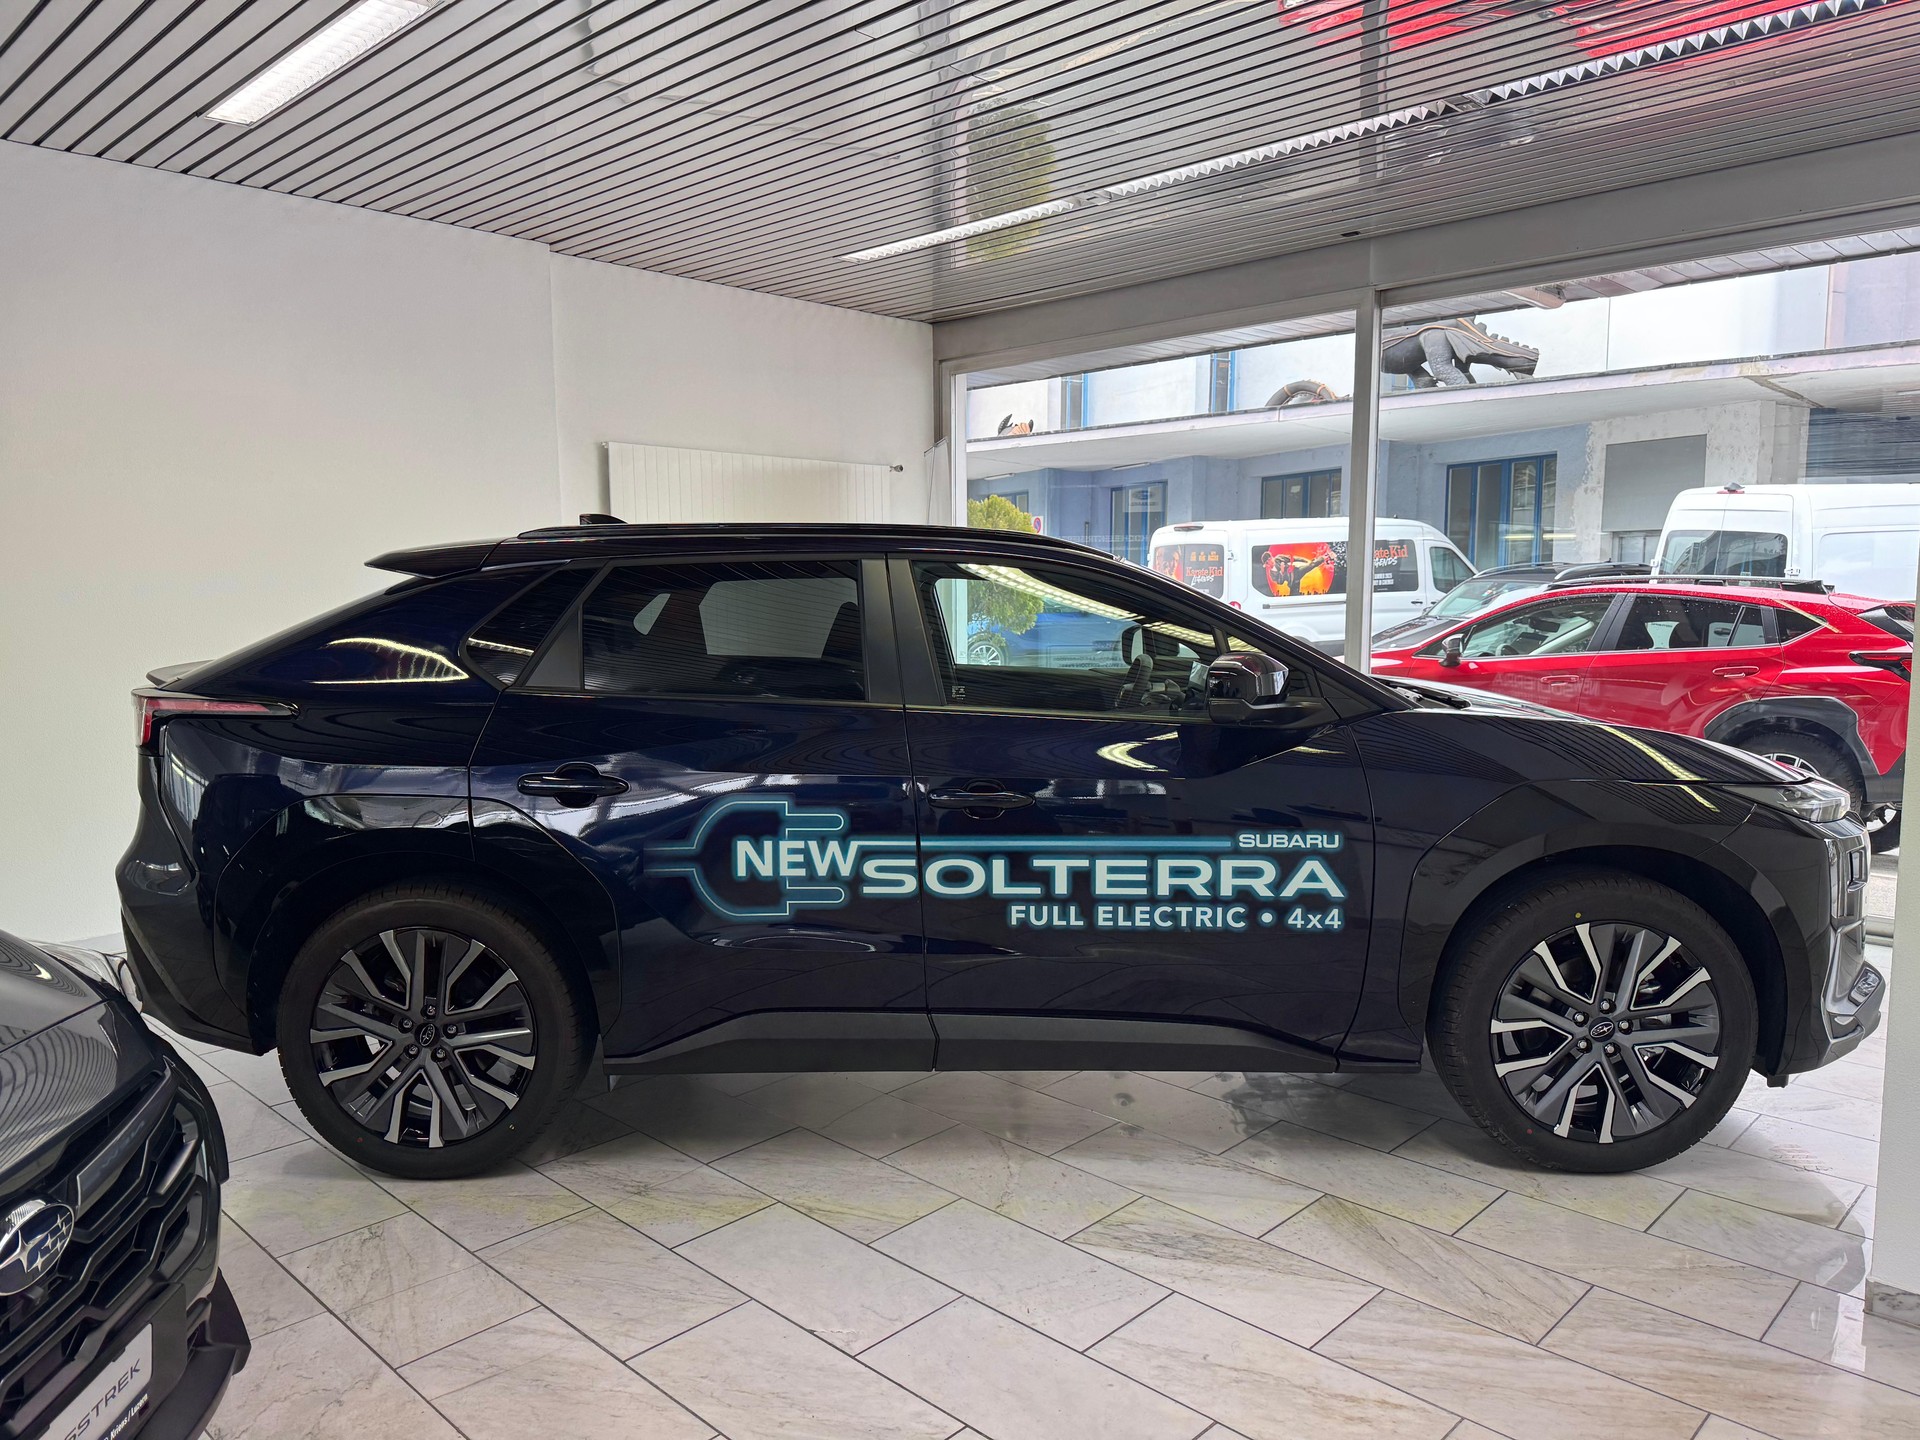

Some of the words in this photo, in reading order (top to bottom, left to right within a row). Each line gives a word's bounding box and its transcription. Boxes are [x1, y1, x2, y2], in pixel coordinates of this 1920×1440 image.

[1389, 544, 1408, 558] Kid
[1185, 567, 1208, 577] Karate
[1208, 566, 1224, 577] Kid
[1238, 834, 1339, 848] SUBARU
[737, 840, 859, 877] NEW
[862, 859, 1345, 898] SOLTERRA
[1011, 905, 1084, 926] FULL
[1098, 906, 1246, 928] ELECTRIC
[1287, 908, 1342, 929] 4x4
